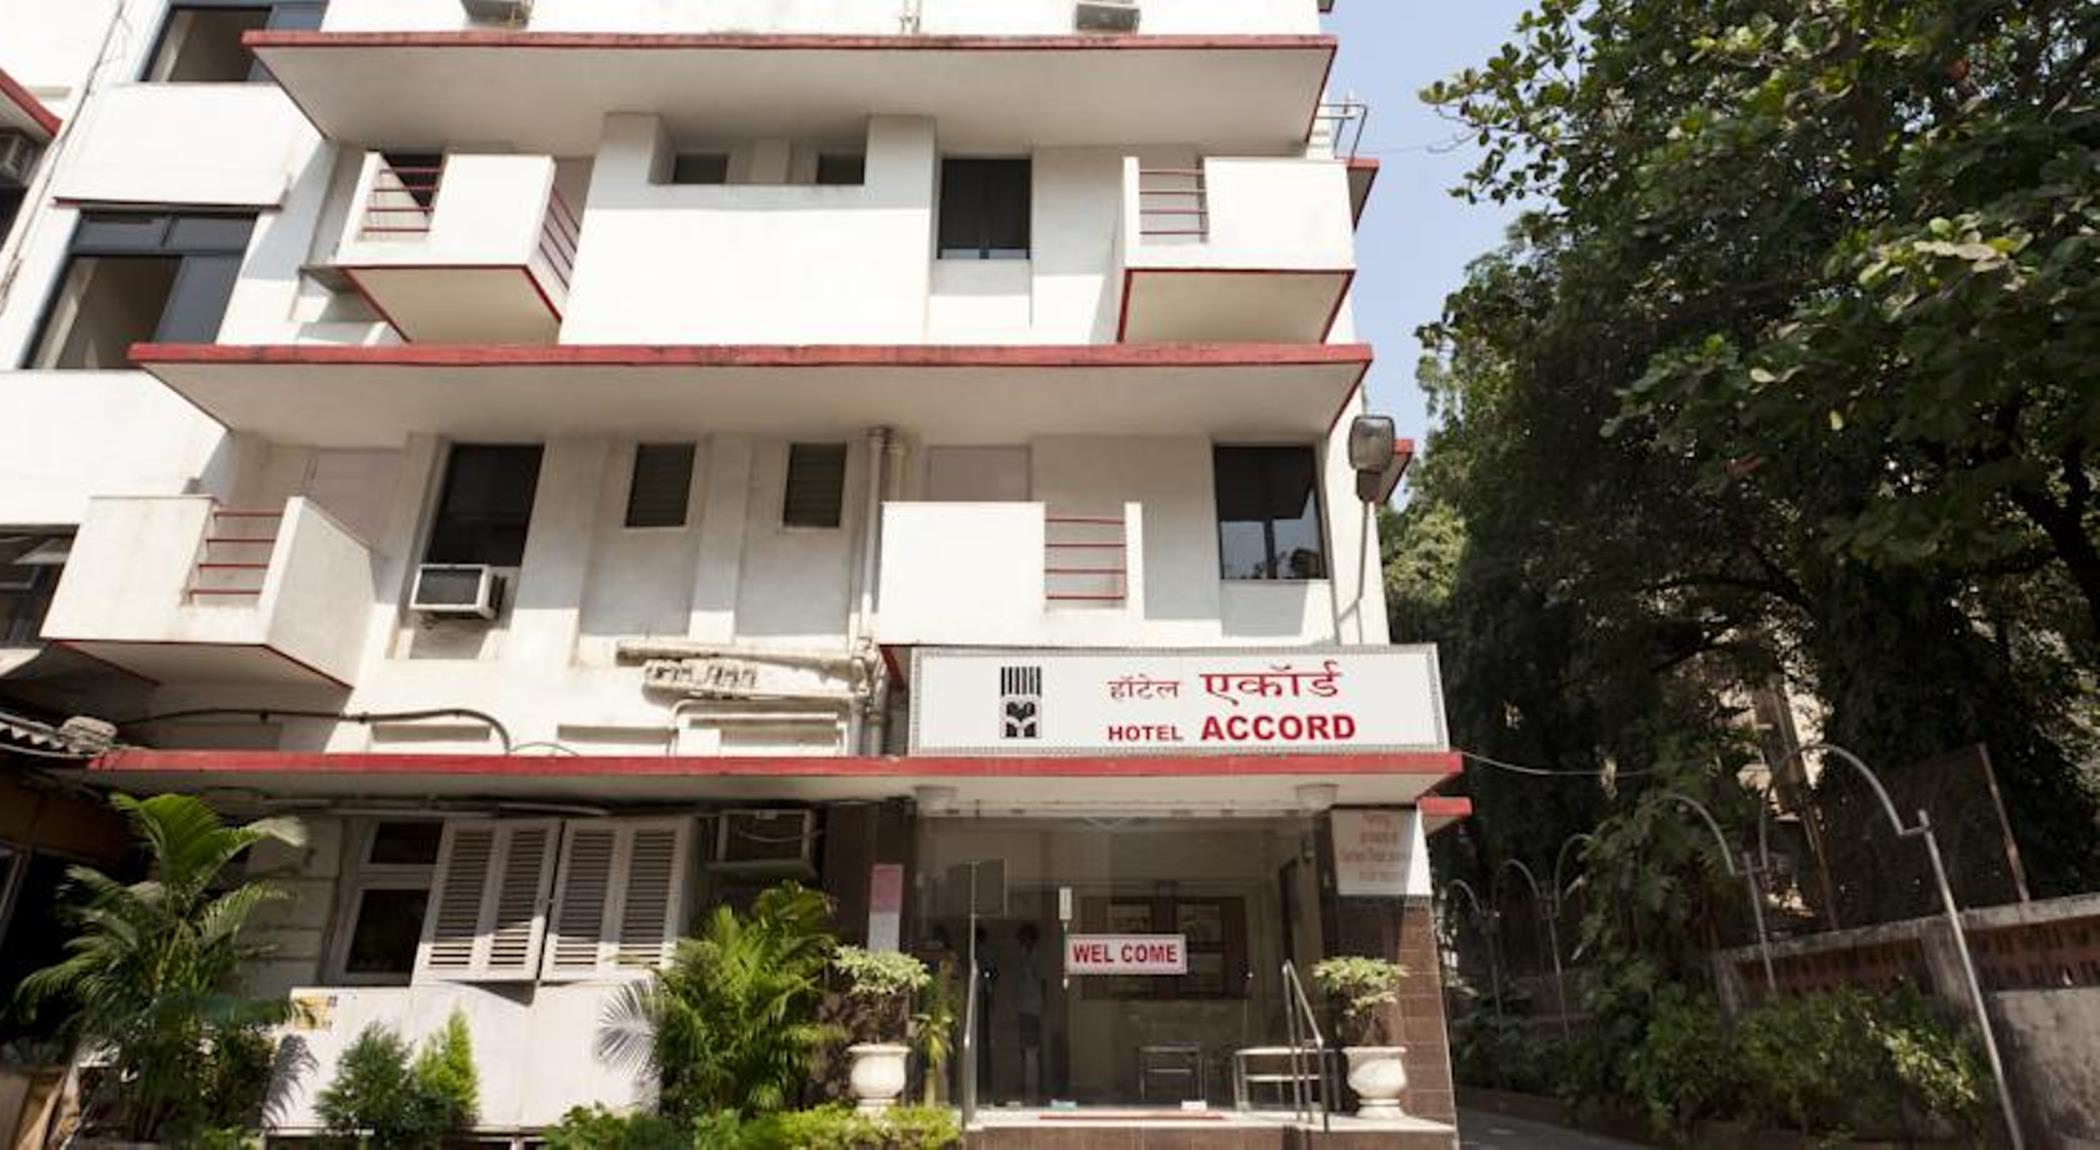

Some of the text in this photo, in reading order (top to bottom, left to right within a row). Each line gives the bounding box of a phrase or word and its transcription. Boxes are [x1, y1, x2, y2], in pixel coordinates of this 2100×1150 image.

[1107, 660, 1343, 706] हॉटेल एकॉर्ड
[1108, 715, 1356, 741] HOTEL ACCORD
[1073, 944, 1178, 963] WEL COME
